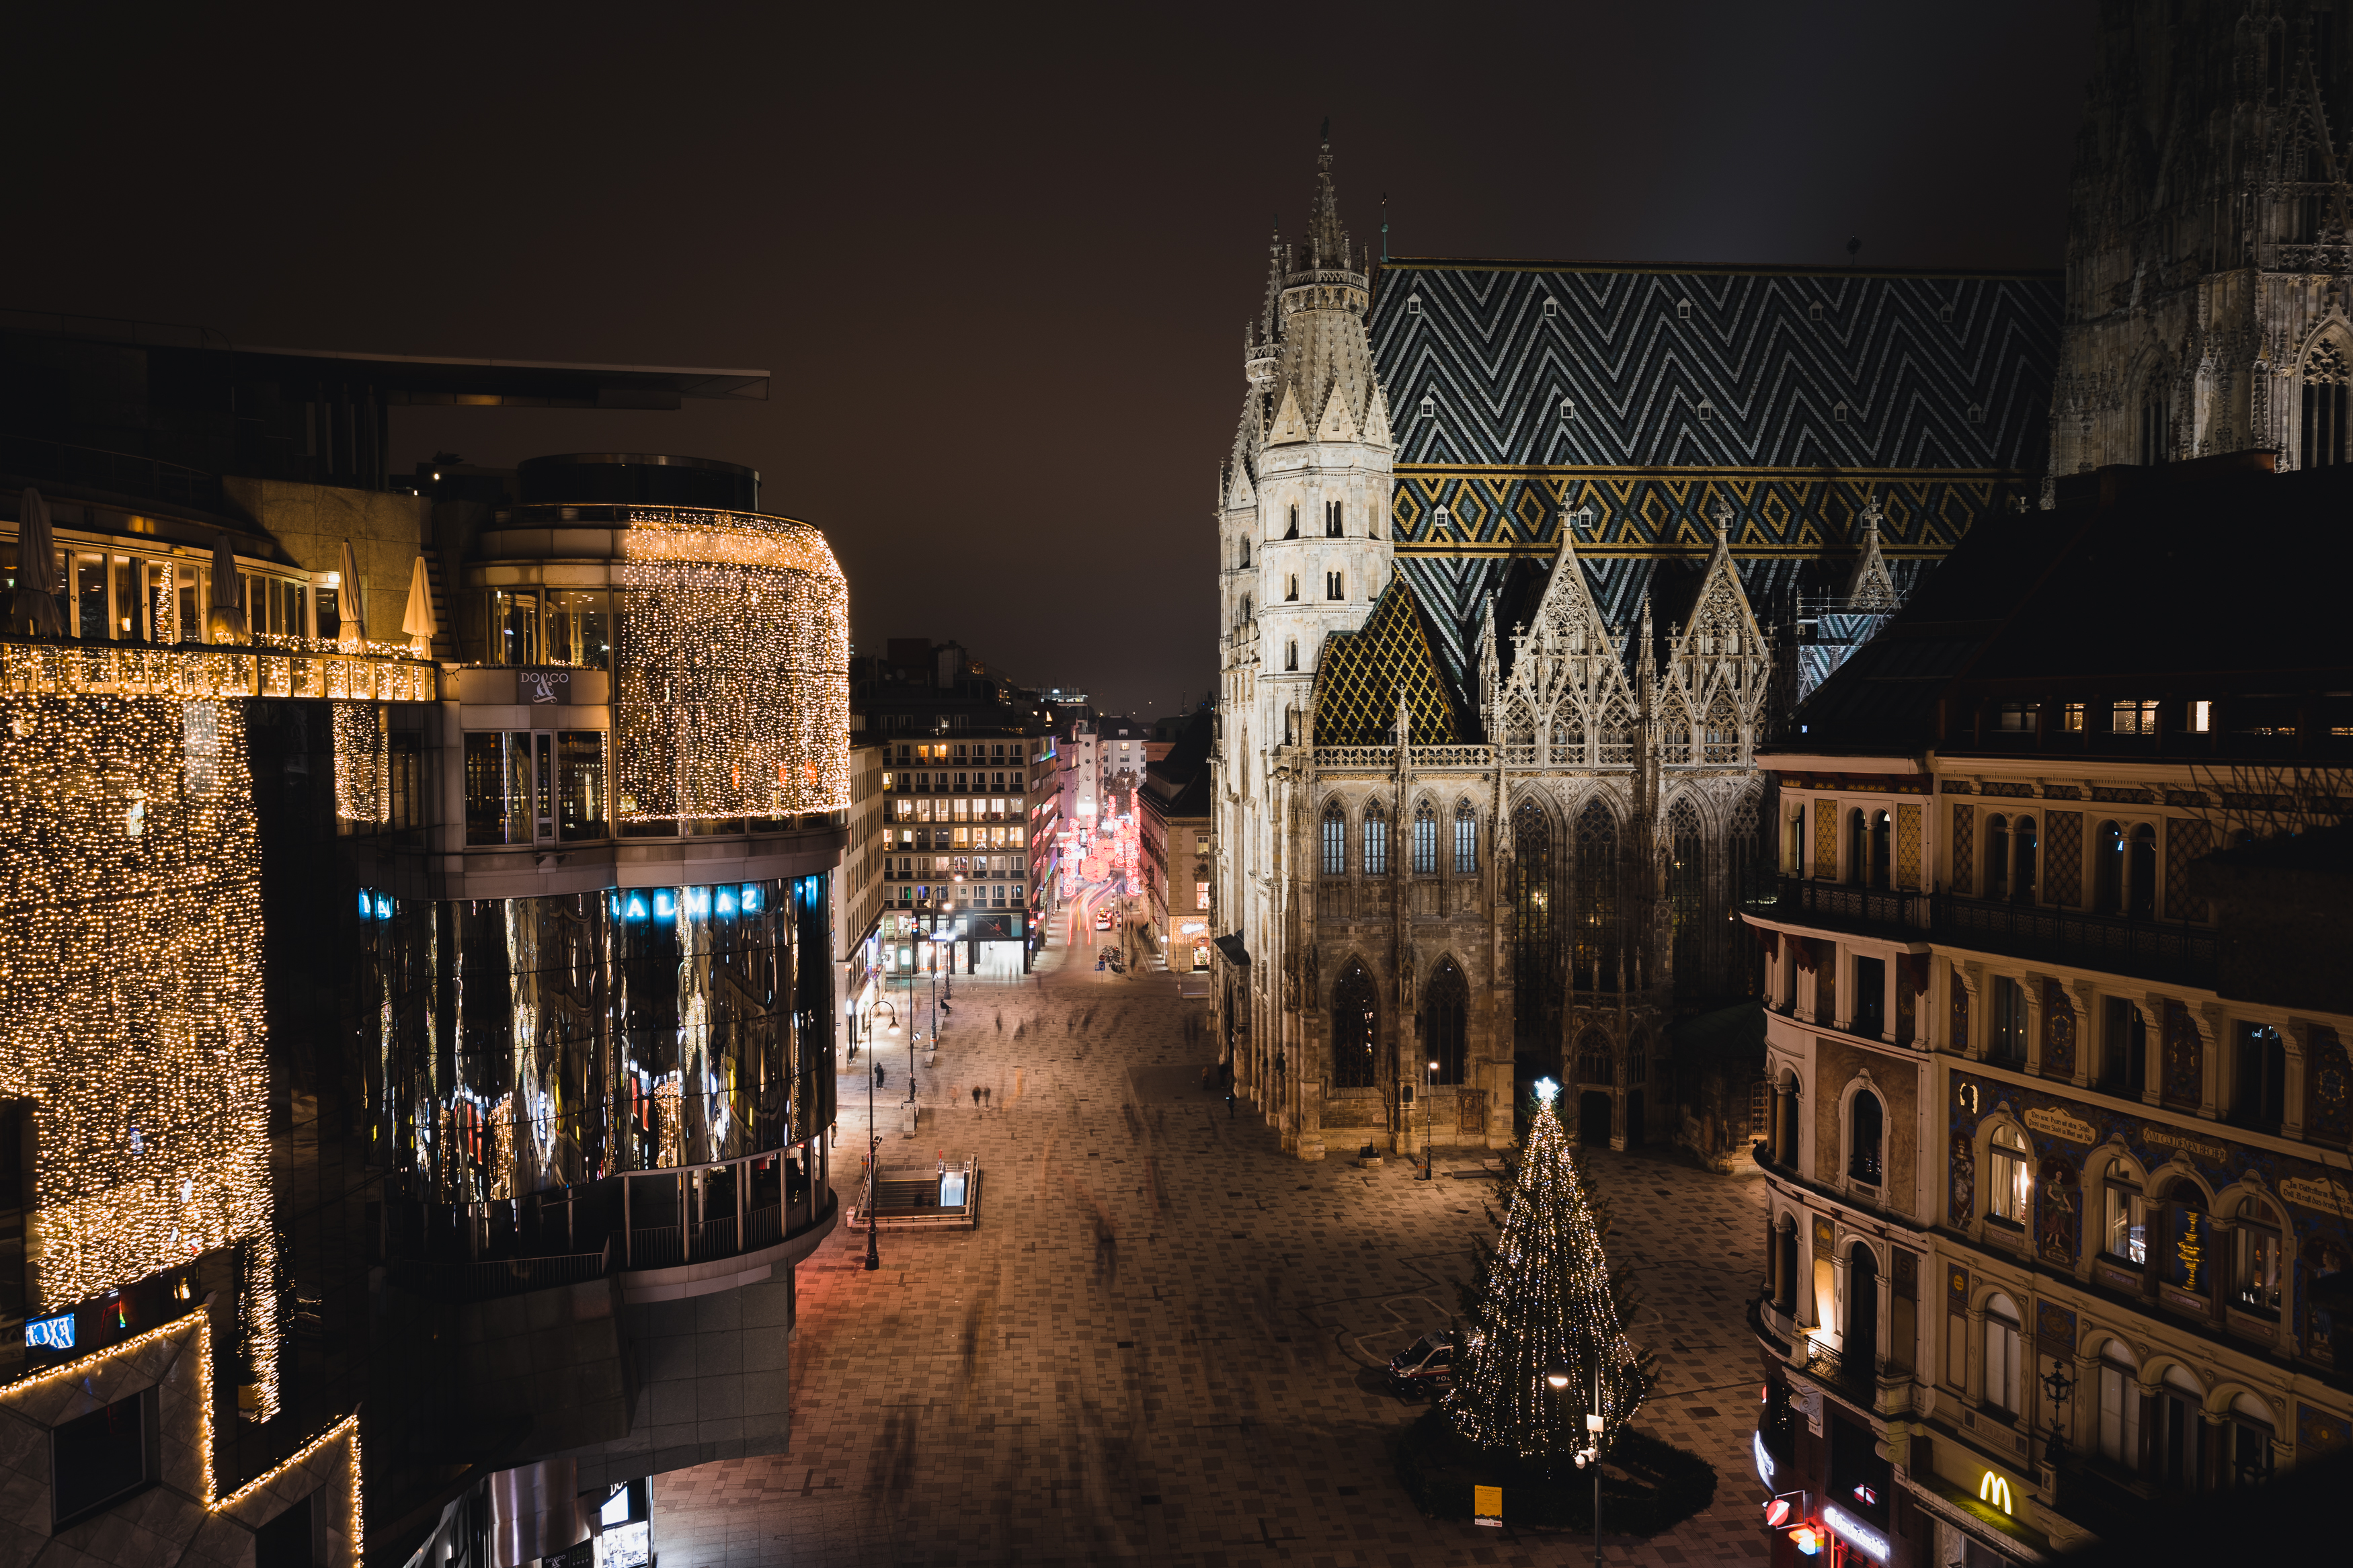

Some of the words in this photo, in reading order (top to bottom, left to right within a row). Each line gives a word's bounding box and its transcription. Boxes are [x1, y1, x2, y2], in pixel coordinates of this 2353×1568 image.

[627, 891, 756, 916] ALMAZ
[2031, 1111, 2040, 1119] Das
[2200, 1145, 2225, 1160] BECHER
[2311, 1197, 2322, 1206] das
[1395, 1356, 1404, 1366] POLIZEI
[572, 1547, 589, 1556] LAZY
[572, 1553, 589, 1561] CHEF
